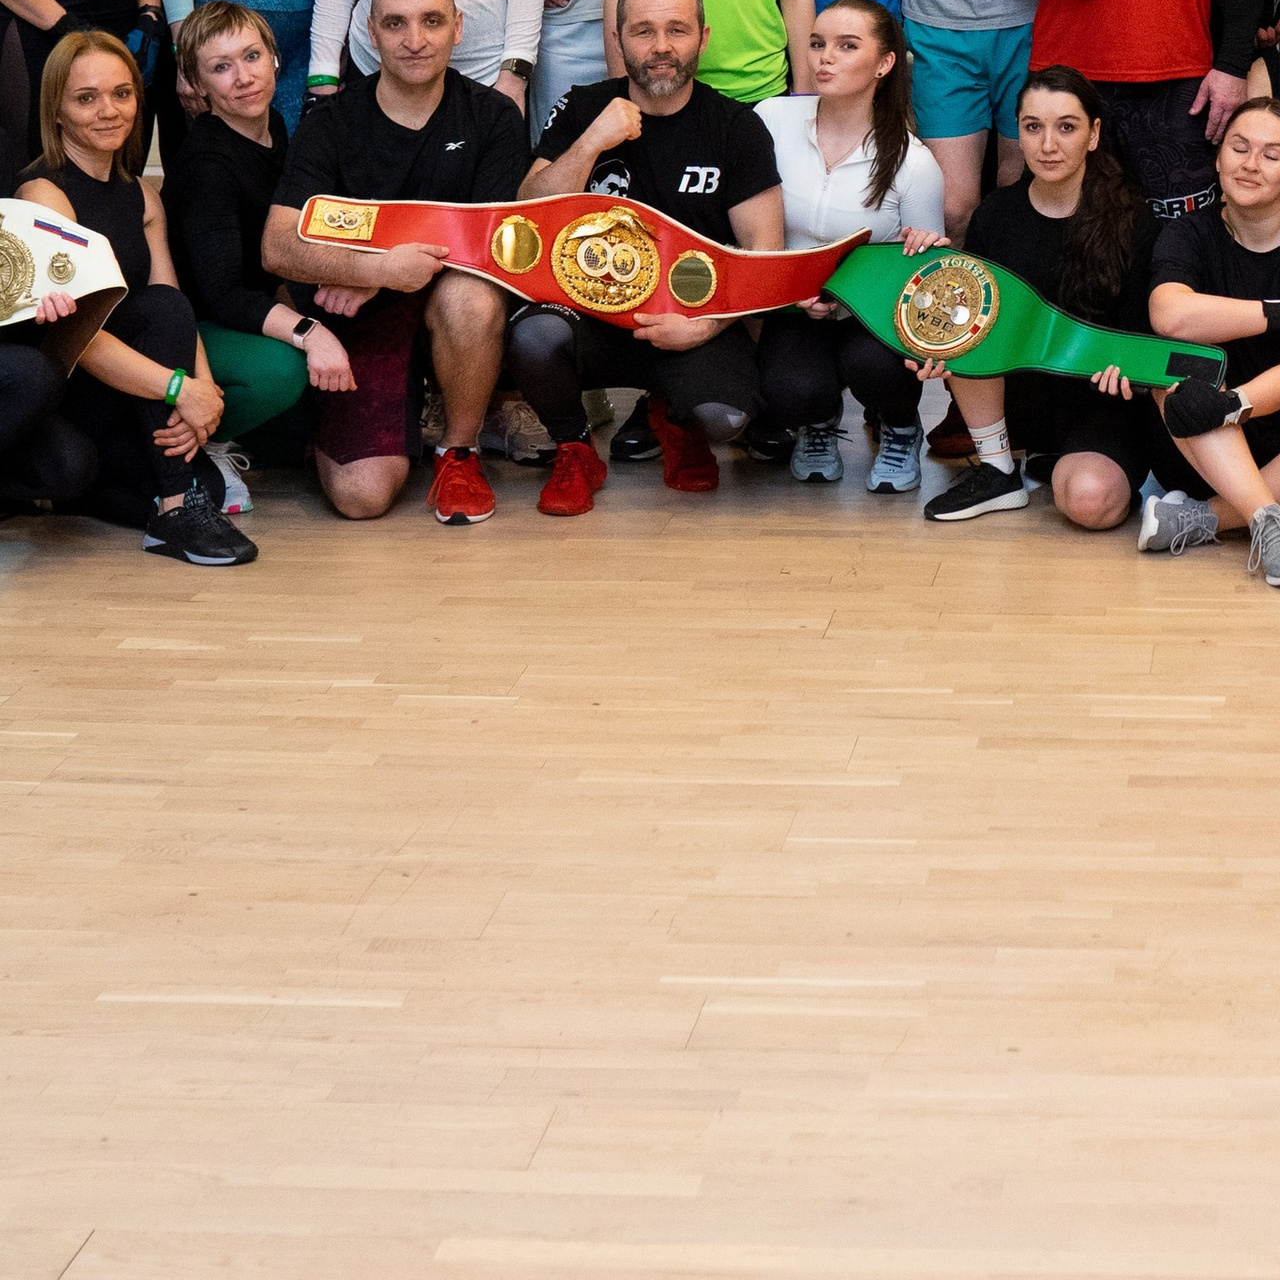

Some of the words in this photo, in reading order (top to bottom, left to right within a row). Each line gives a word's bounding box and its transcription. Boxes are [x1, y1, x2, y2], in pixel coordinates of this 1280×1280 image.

[678, 166, 721, 194] DB
[938, 259, 990, 286] YOUTH
[917, 311, 954, 333] WBC
